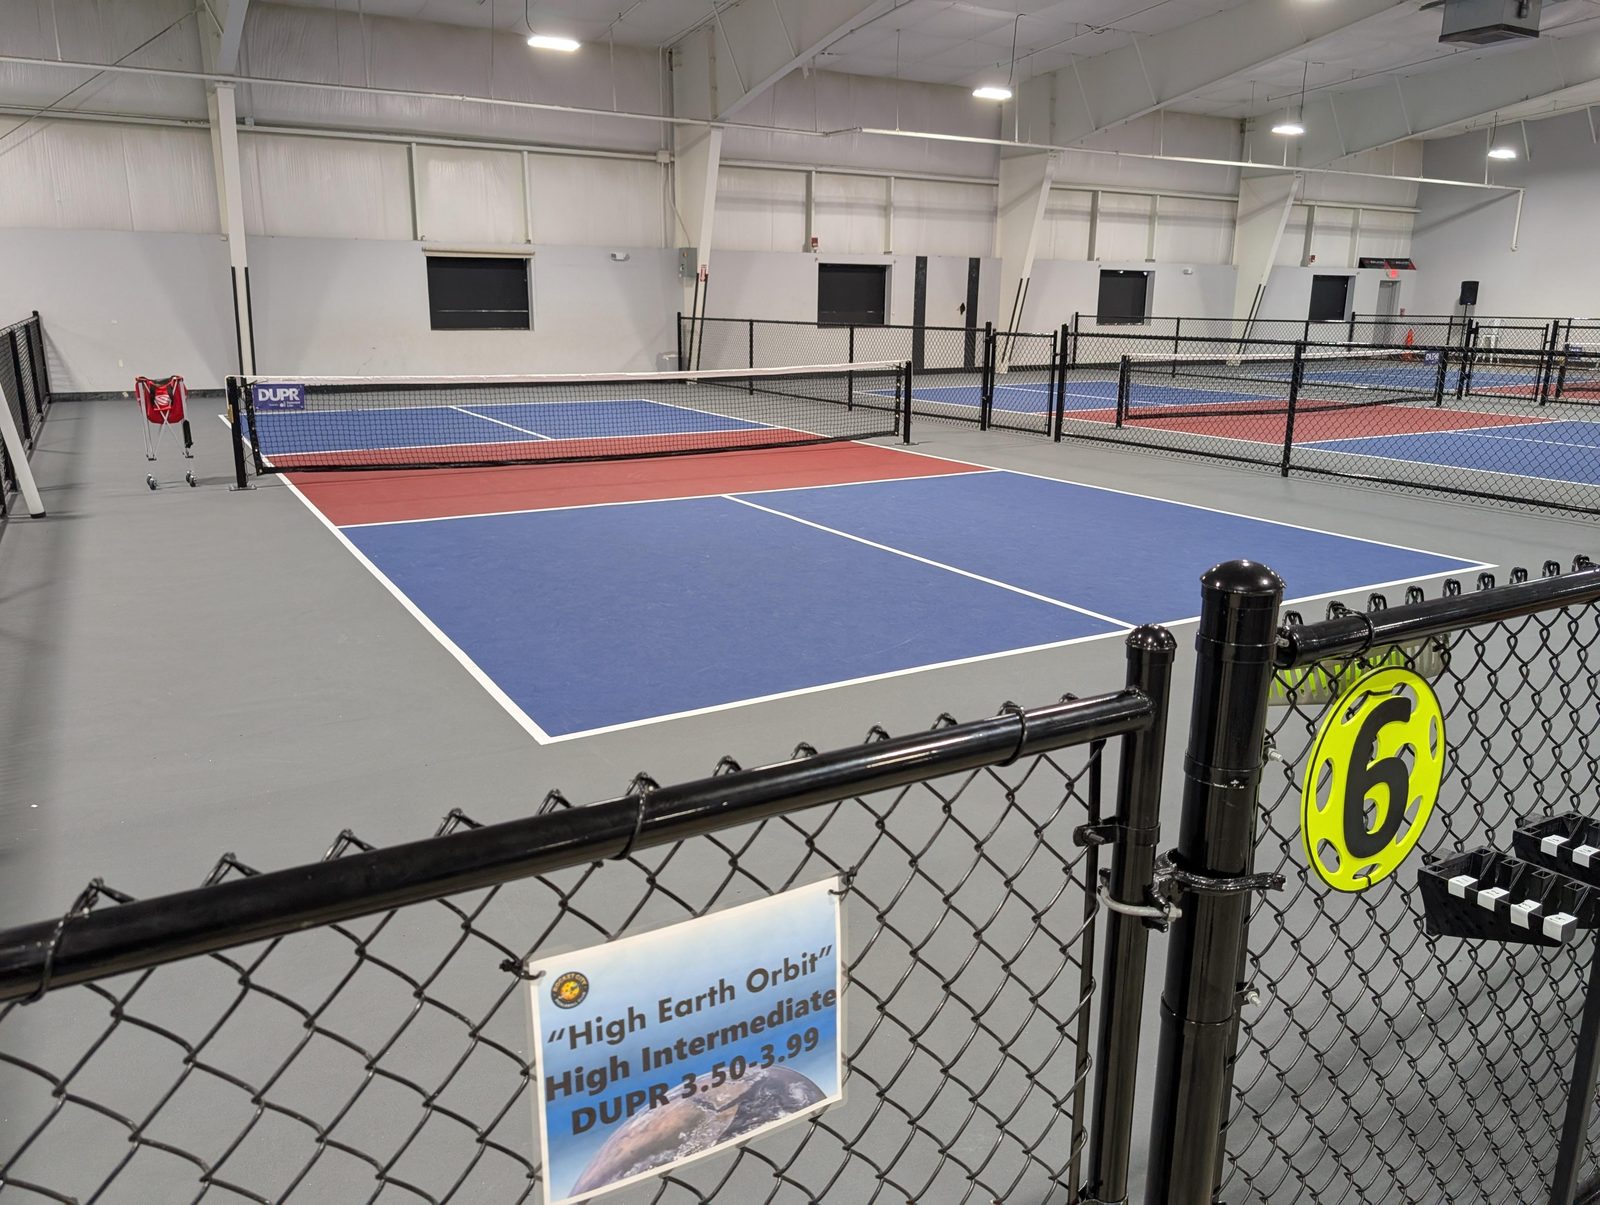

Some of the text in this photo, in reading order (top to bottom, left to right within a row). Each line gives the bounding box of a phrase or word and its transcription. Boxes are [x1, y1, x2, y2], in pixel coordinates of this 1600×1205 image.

[258, 388, 300, 401] DUPR
[1343, 696, 1411, 858] 6
[546, 988, 837, 1101] High Intermediate
[658, 978, 735, 1024] Earth
[572, 1027, 819, 1135] DUPR 3.50-3.99
